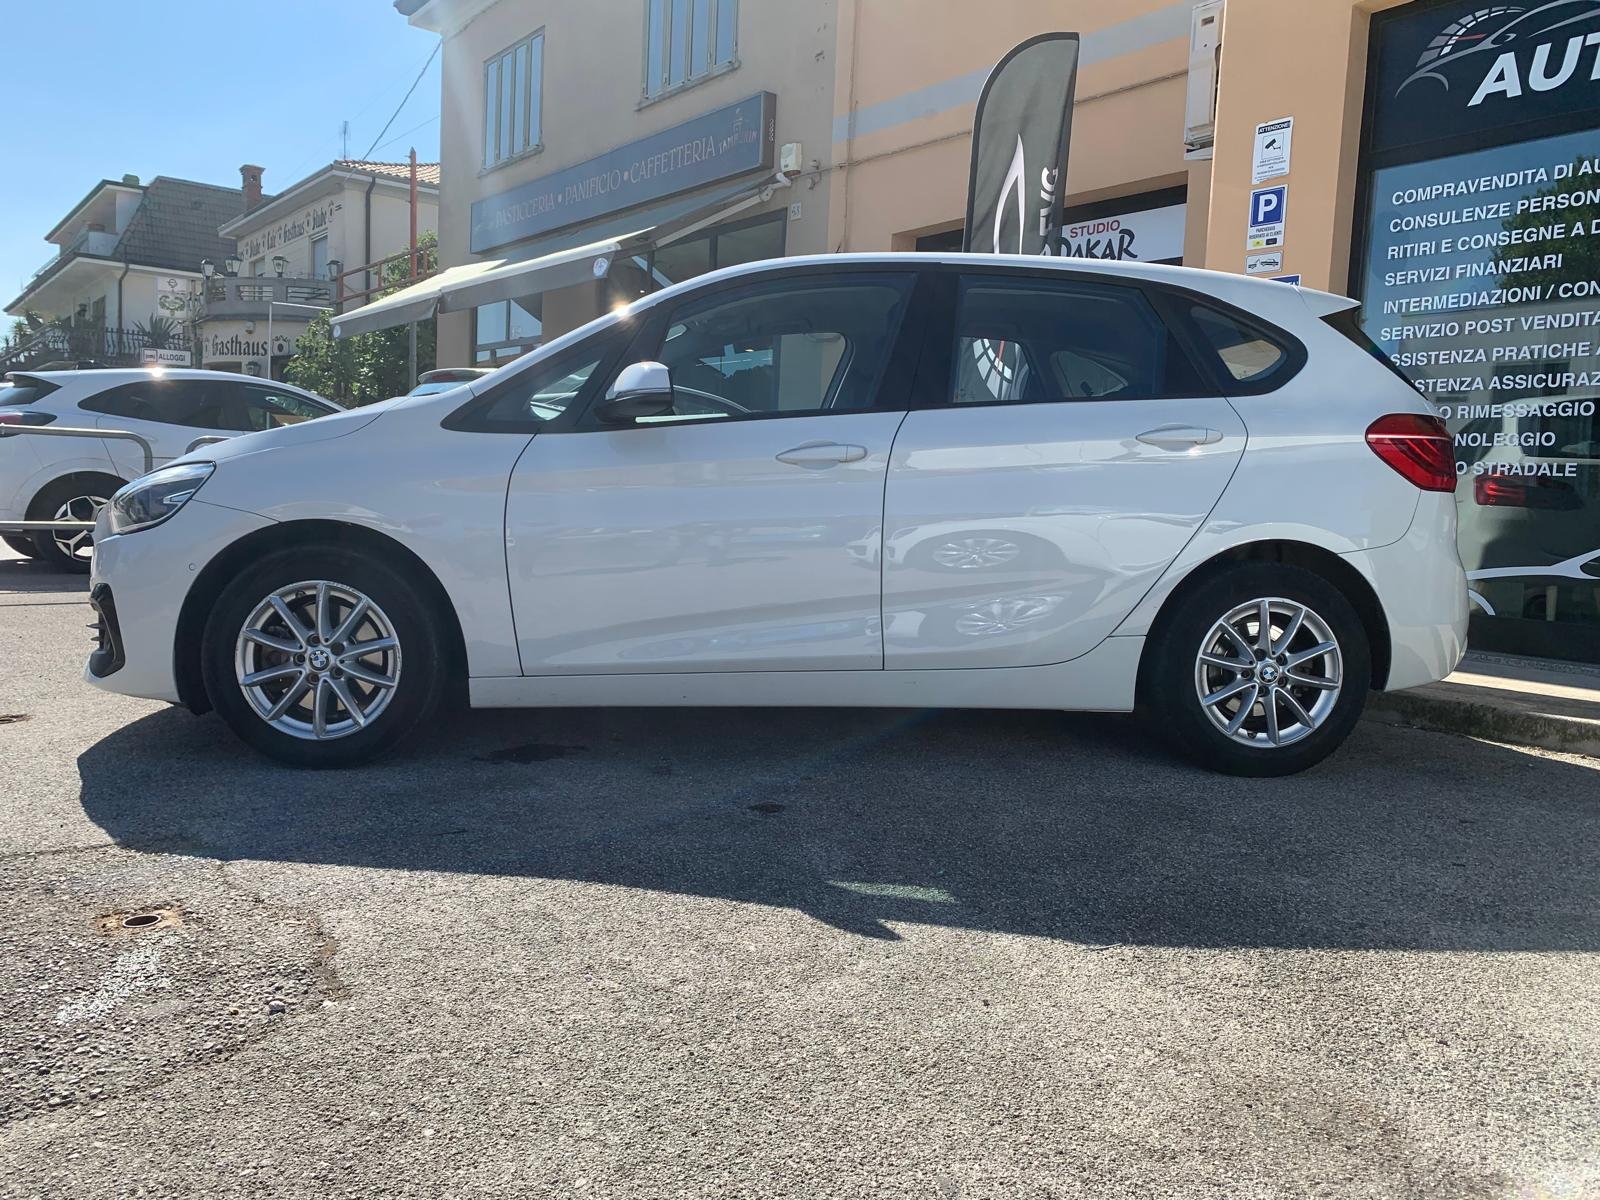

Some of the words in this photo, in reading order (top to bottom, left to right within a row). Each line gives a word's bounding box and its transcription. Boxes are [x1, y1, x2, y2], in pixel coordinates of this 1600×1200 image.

[1259, 122, 1290, 133] ATTENZIONE
[565, 169, 621, 205] PANIFICIO
[630, 135, 716, 184] CAFFETTERIA
[1391, 167, 1548, 206] COMPRAVENDITA
[1553, 162, 1574, 180] DI
[1258, 193, 1278, 222] P
[1389, 202, 1511, 233] CONSULENZE
[1516, 189, 1600, 215] PERSON
[1070, 220, 1120, 238] STUDIO
[1387, 241, 1436, 260] RITIRI
[1441, 239, 1453, 252] E
[1457, 223, 1566, 251] CONSEGNE
[1570, 221, 1585, 237] A
[1384, 267, 1450, 287] SERVIZI
[1455, 253, 1563, 279] FINANZIARI
[1383, 285, 1541, 314] INTERMEDIAZIONI
[1380, 322, 1459, 341] SERVIZIO
[1464, 317, 1515, 335] POST
[158, 353, 186, 362] ALLOGGI
[212, 334, 268, 357] Gasthaus
[1390, 349, 1487, 367] SSISTENZA
[1492, 341, 1591, 361] PRATICHE
[1412, 377, 1484, 393] STENZA
[1488, 371, 1600, 390] ASSICURAZ
[1457, 401, 1596, 419] RIMESSAGGIO
[1454, 431, 1556, 447] NOLEGGIO
[1473, 462, 1578, 477] STRADALE
